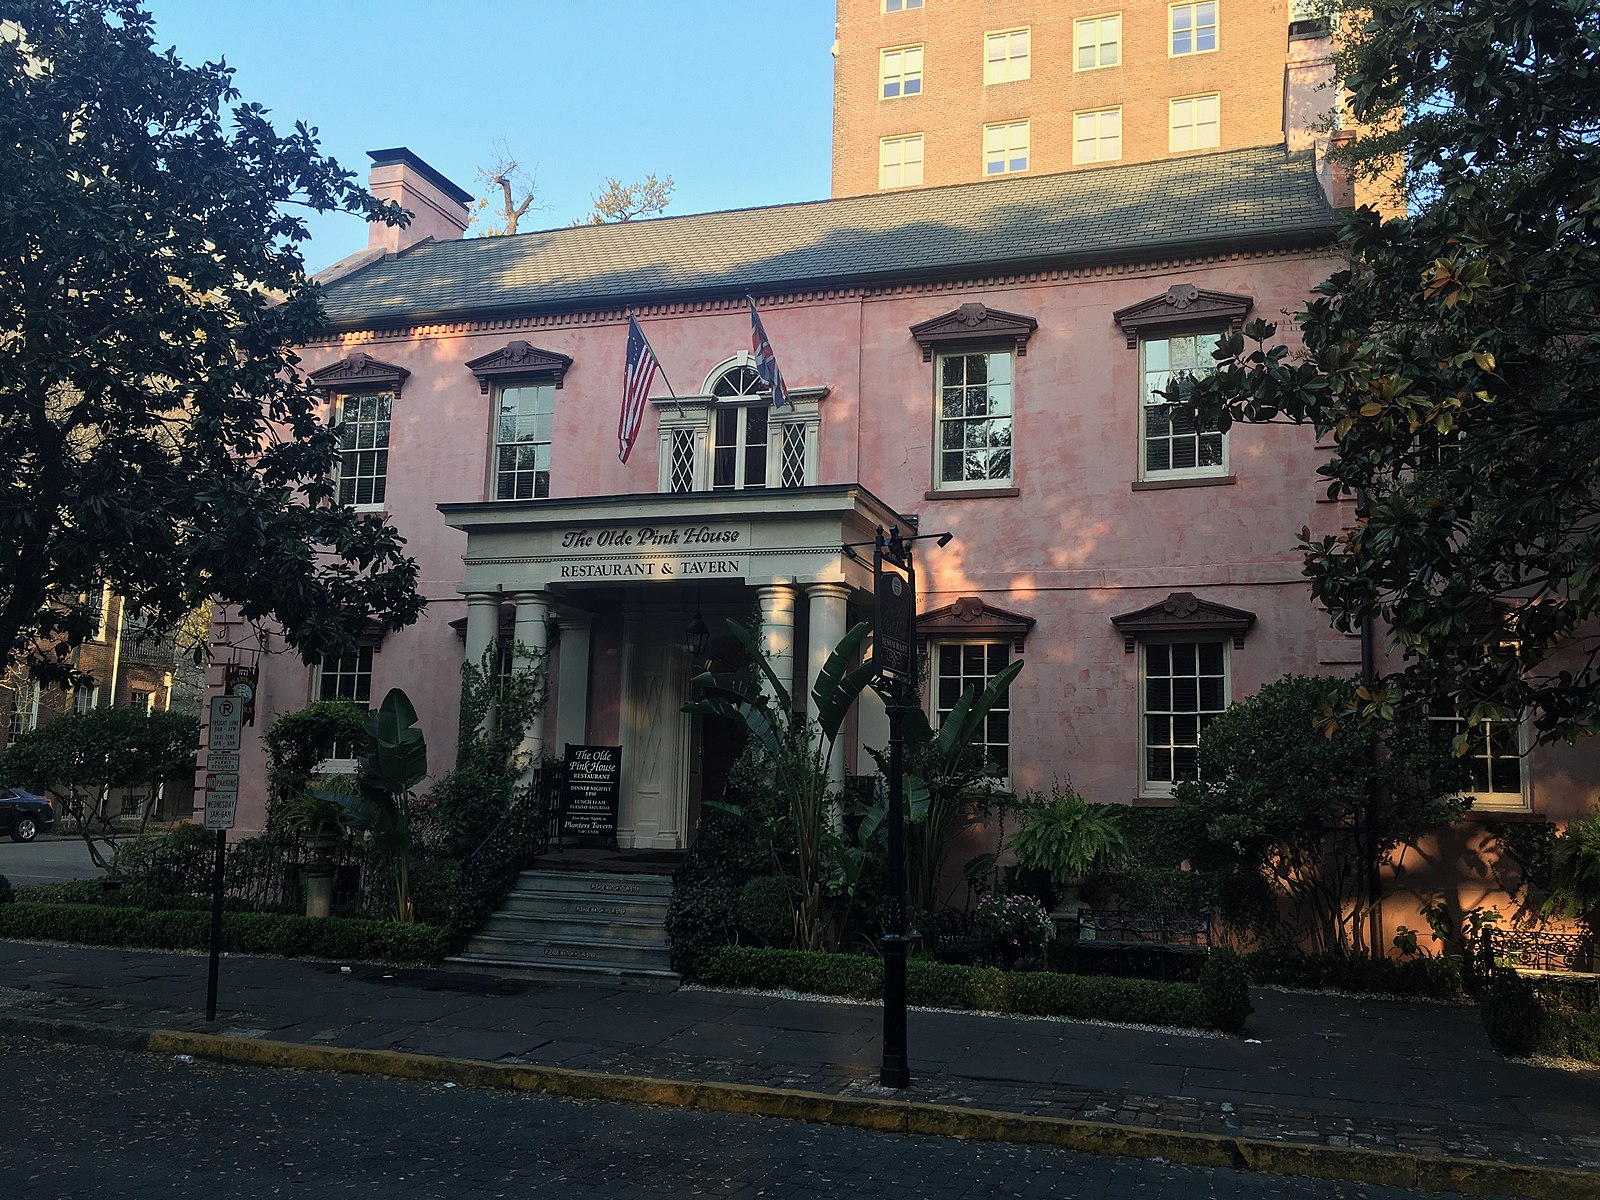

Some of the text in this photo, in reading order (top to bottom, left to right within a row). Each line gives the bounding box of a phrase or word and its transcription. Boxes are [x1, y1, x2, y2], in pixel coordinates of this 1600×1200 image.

[562, 526, 741, 548] The Olde Pink House
[561, 560, 741, 577] RESTAURANT & TAVERN
[575, 750, 612, 761] The Olde
[569, 761, 616, 774] Pink House
[207, 778, 237, 788] NO PARKING
[208, 801, 234, 809] WEDNESDAY
[565, 821, 613, 830] Planters Tavern
